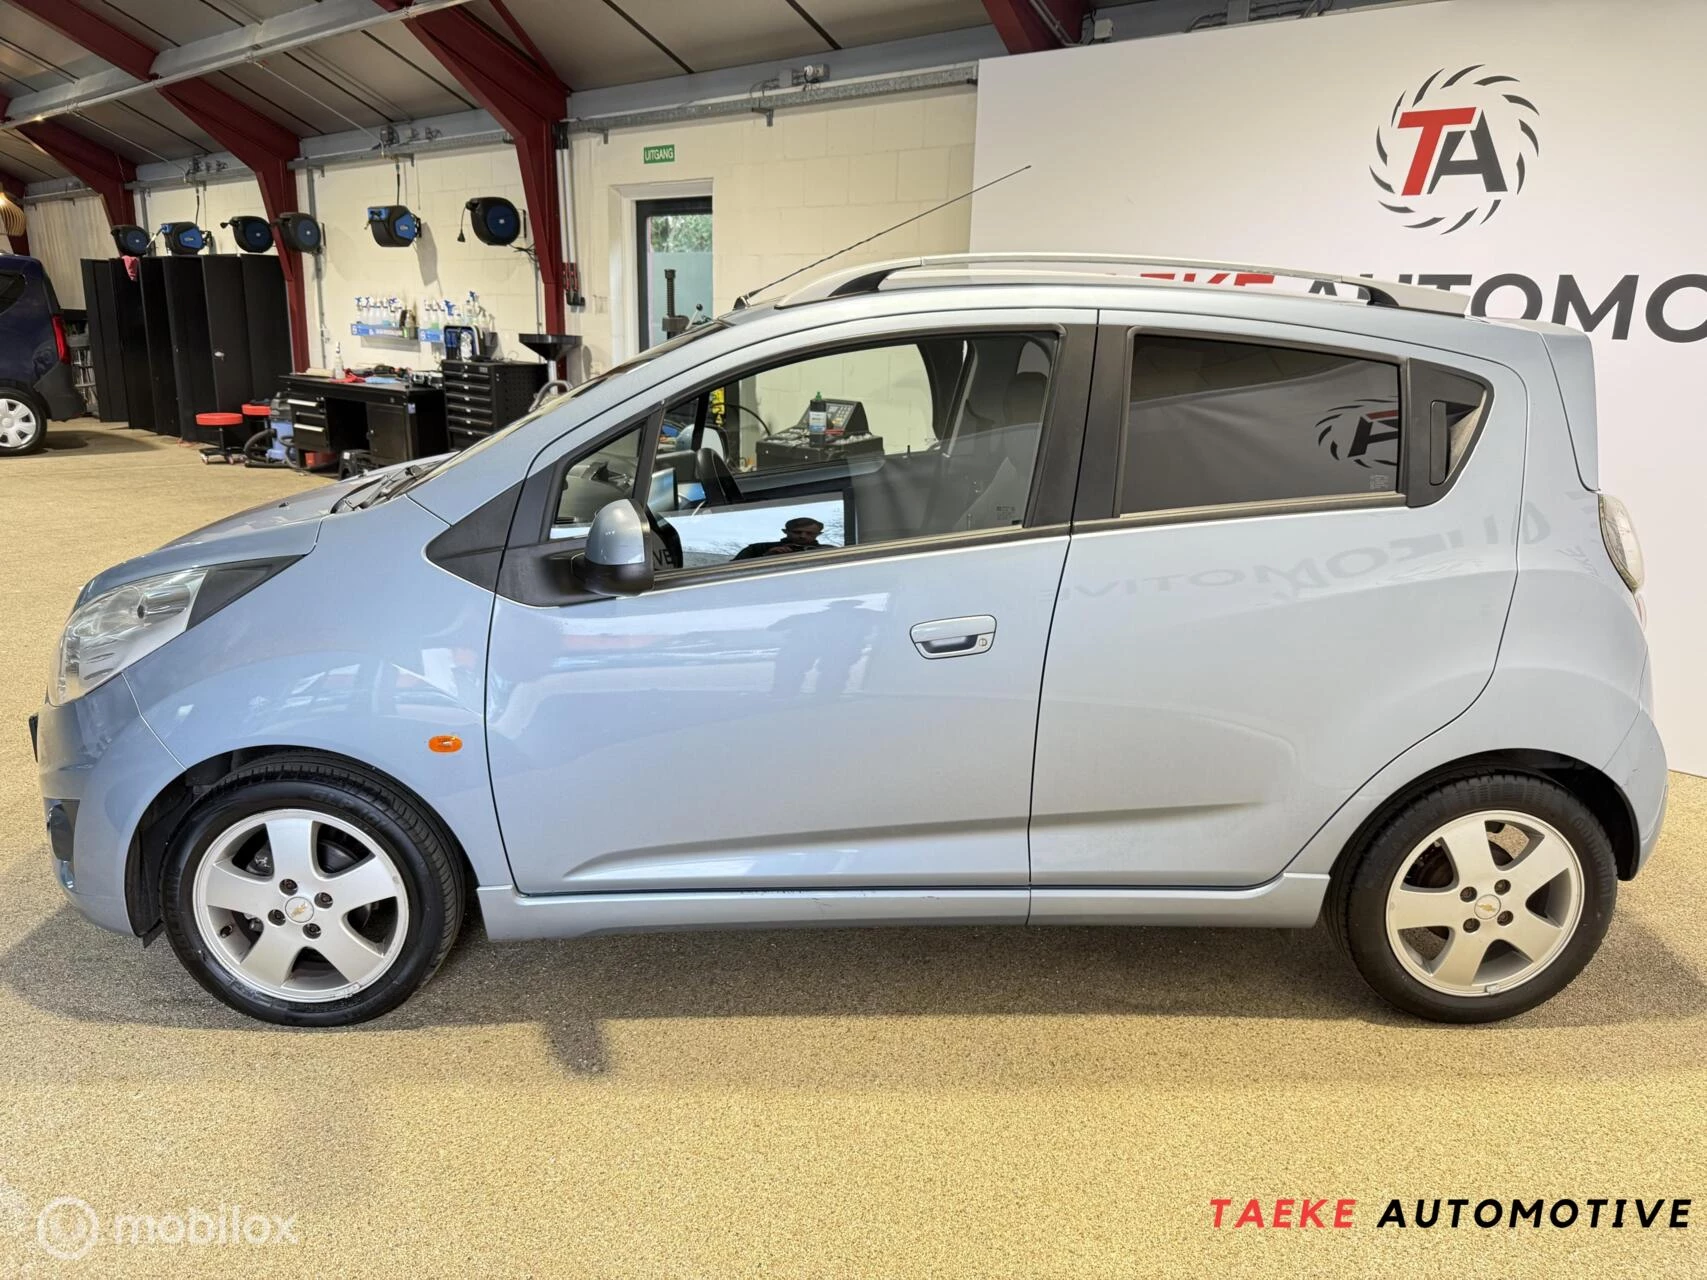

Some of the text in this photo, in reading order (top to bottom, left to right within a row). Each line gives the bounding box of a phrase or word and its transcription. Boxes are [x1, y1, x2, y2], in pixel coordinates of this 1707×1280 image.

[644, 147, 674, 161] UITGANG
[1397, 107, 1508, 196] TA
[1308, 273, 1707, 343] OMO
